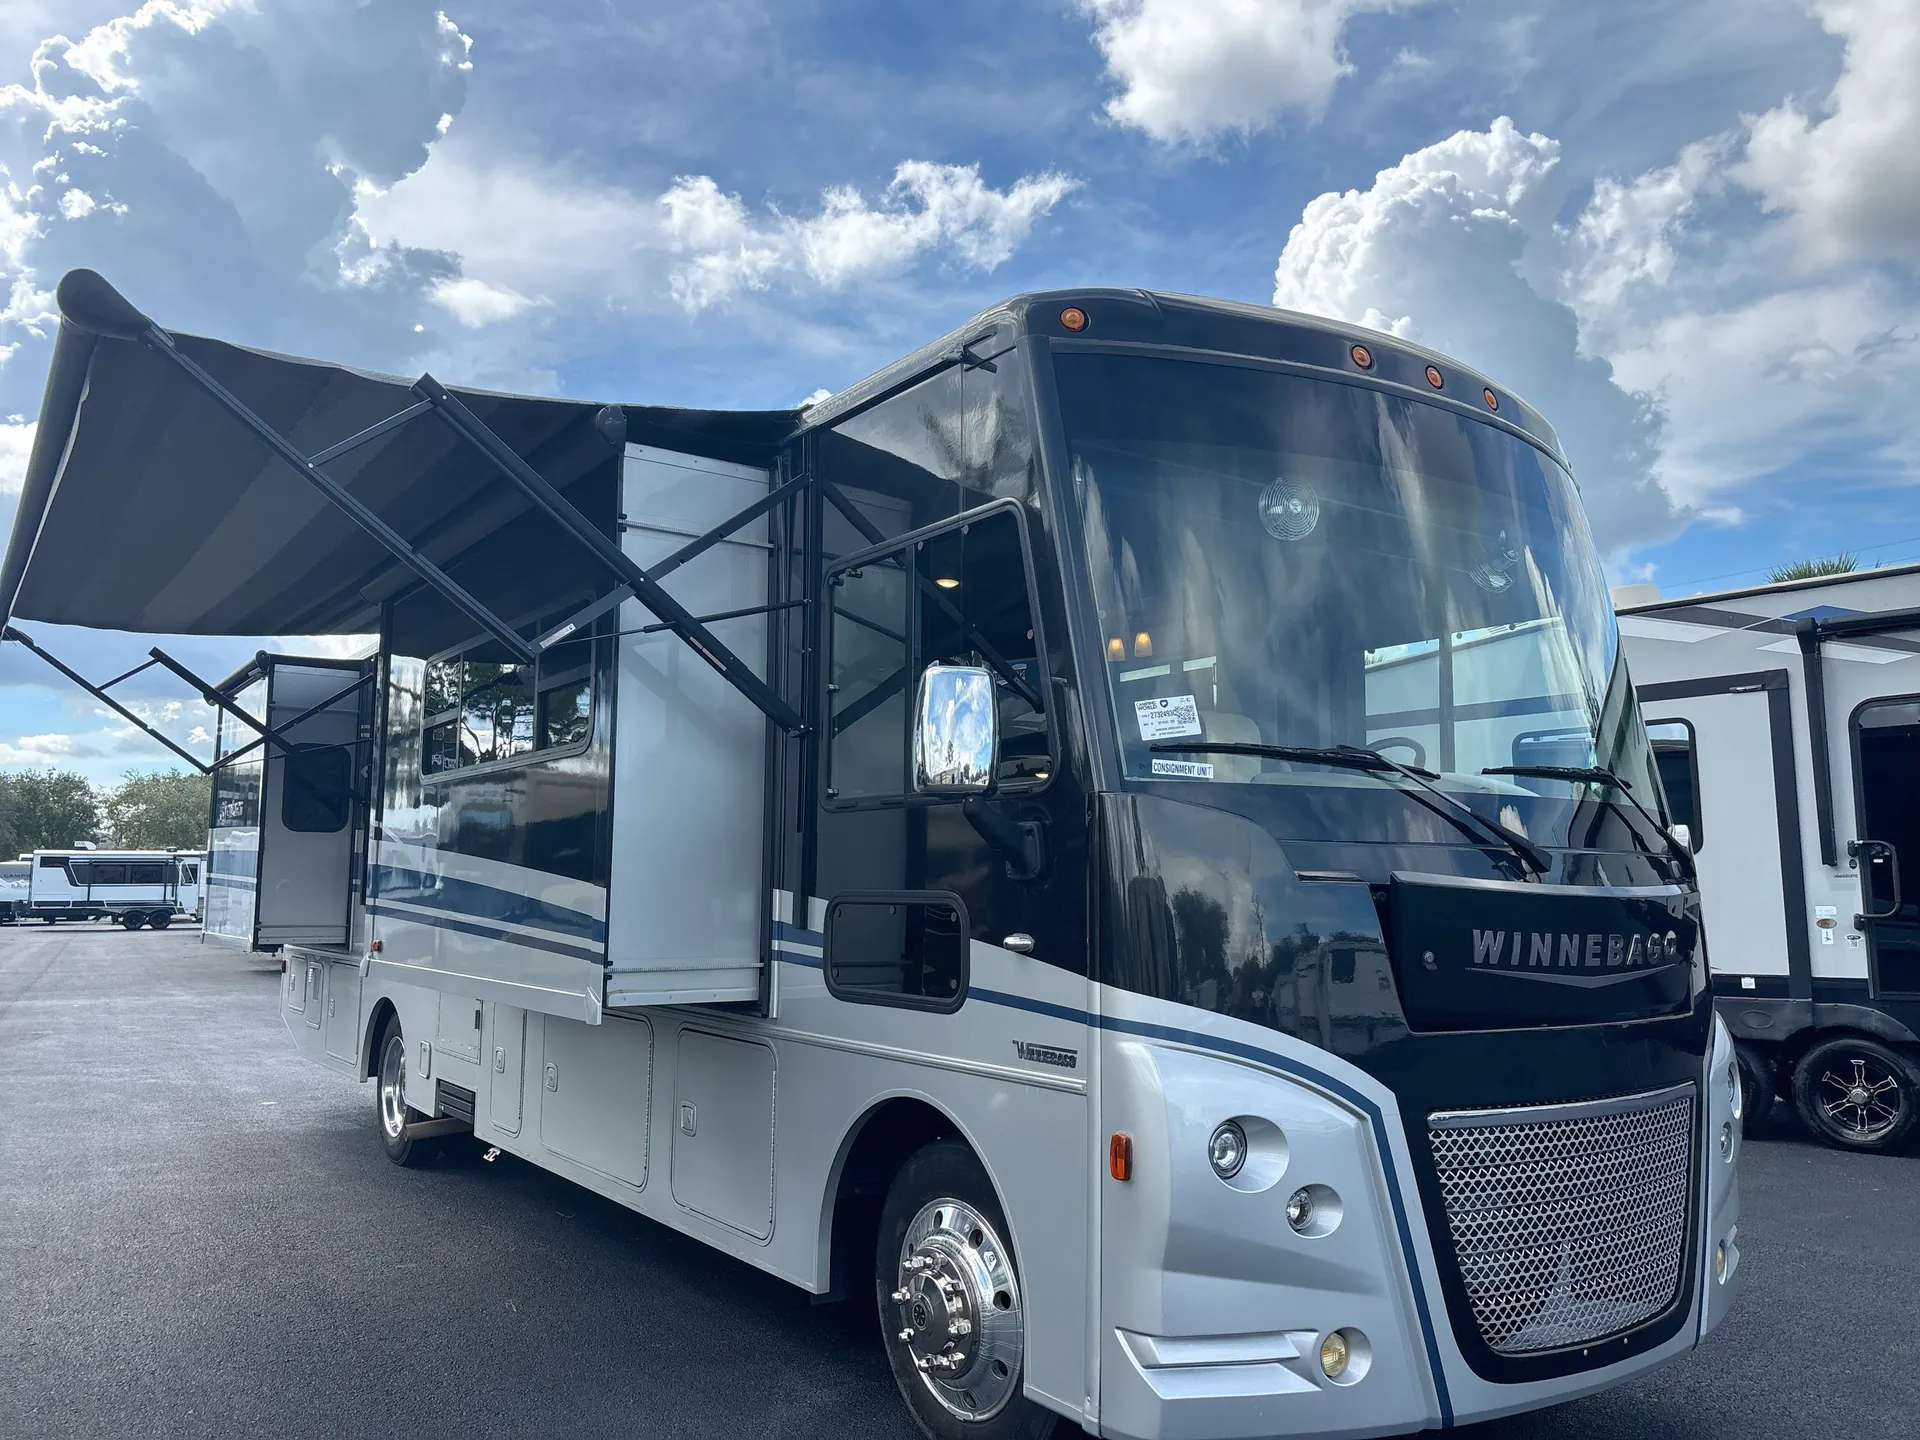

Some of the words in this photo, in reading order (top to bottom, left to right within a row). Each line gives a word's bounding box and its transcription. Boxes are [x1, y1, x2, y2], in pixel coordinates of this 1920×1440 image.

[1153, 762, 1195, 775] CONSIGNMENT
[1197, 766, 1212, 776] UNIT
[1472, 929, 1677, 967] WINNEBAGO
